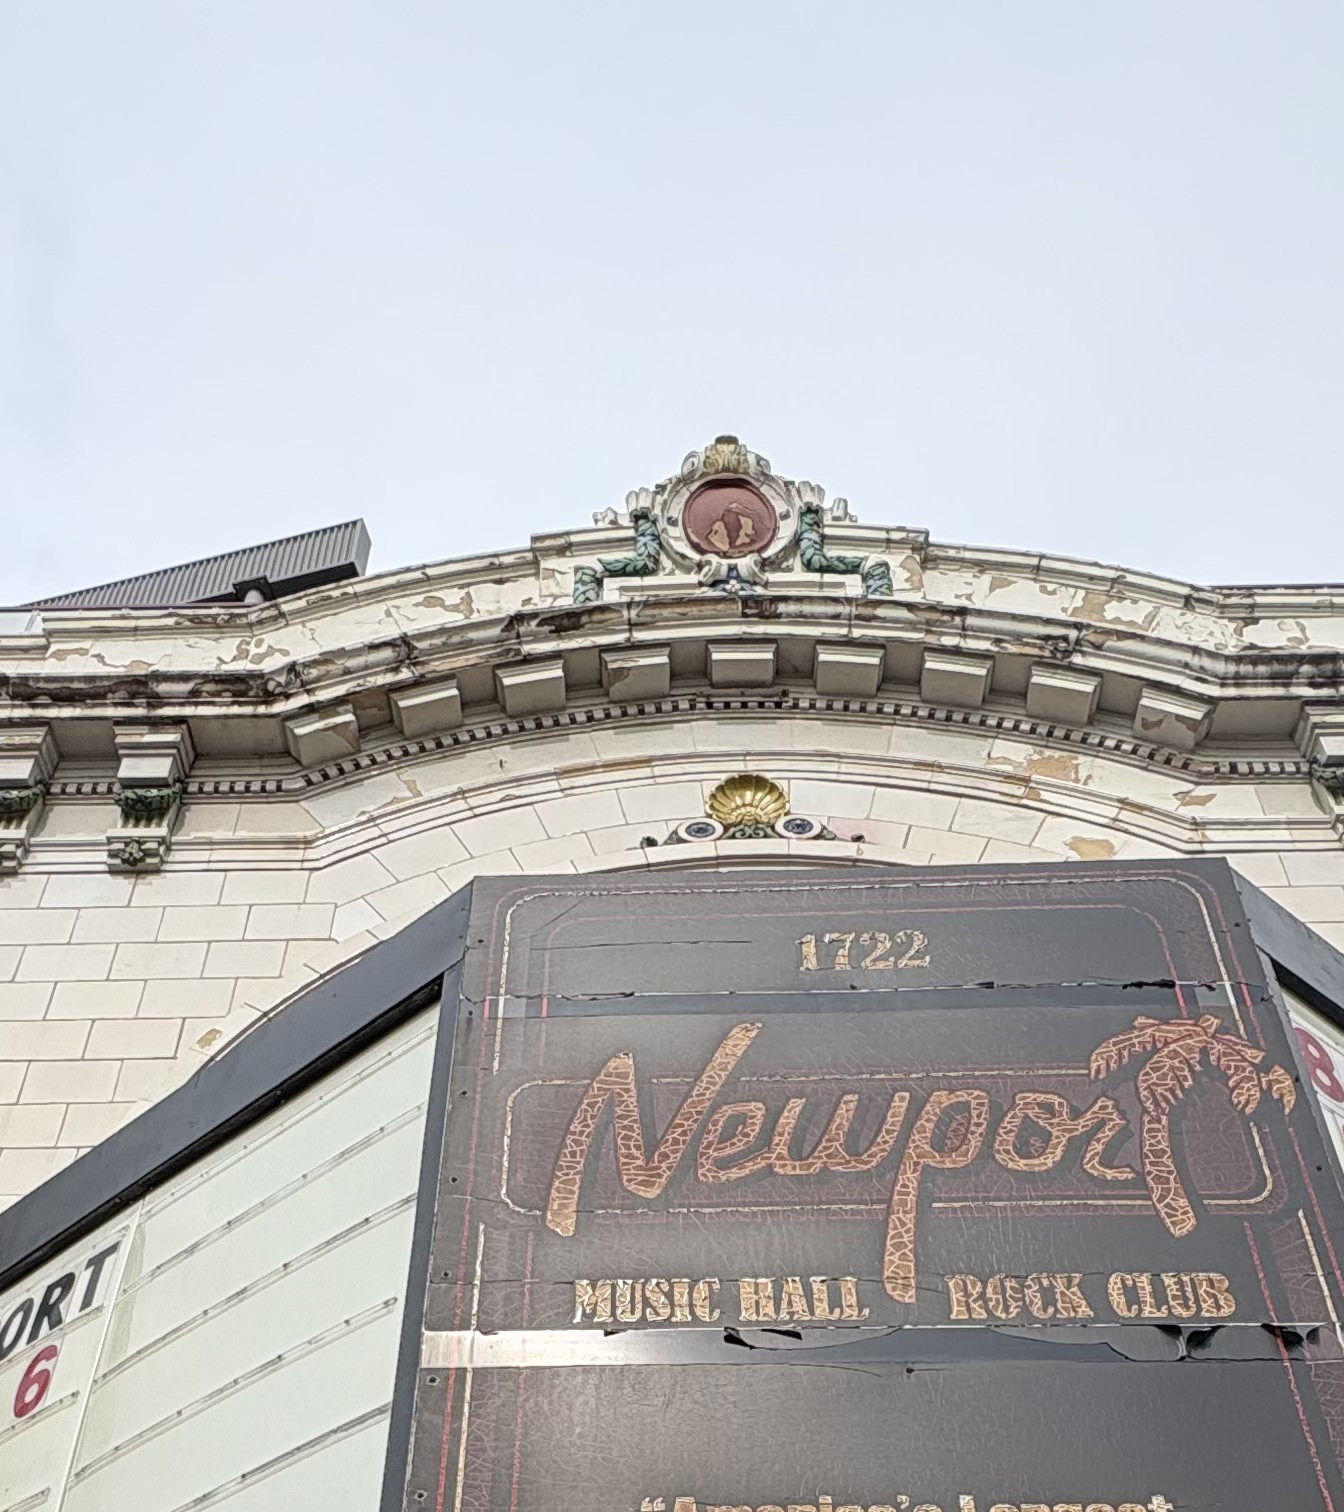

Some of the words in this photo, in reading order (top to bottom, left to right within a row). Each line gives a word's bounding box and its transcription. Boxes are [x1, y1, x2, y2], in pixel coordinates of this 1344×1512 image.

[793, 929, 932, 971] 1722
[545, 1016, 1297, 1304] Newport
[572, 1277, 722, 1324] MUSIC
[739, 1276, 870, 1322] HALL
[947, 1274, 1094, 1320] ROCK
[1110, 1272, 1237, 1319] CLUB
[13, 1344, 60, 1419] 6
